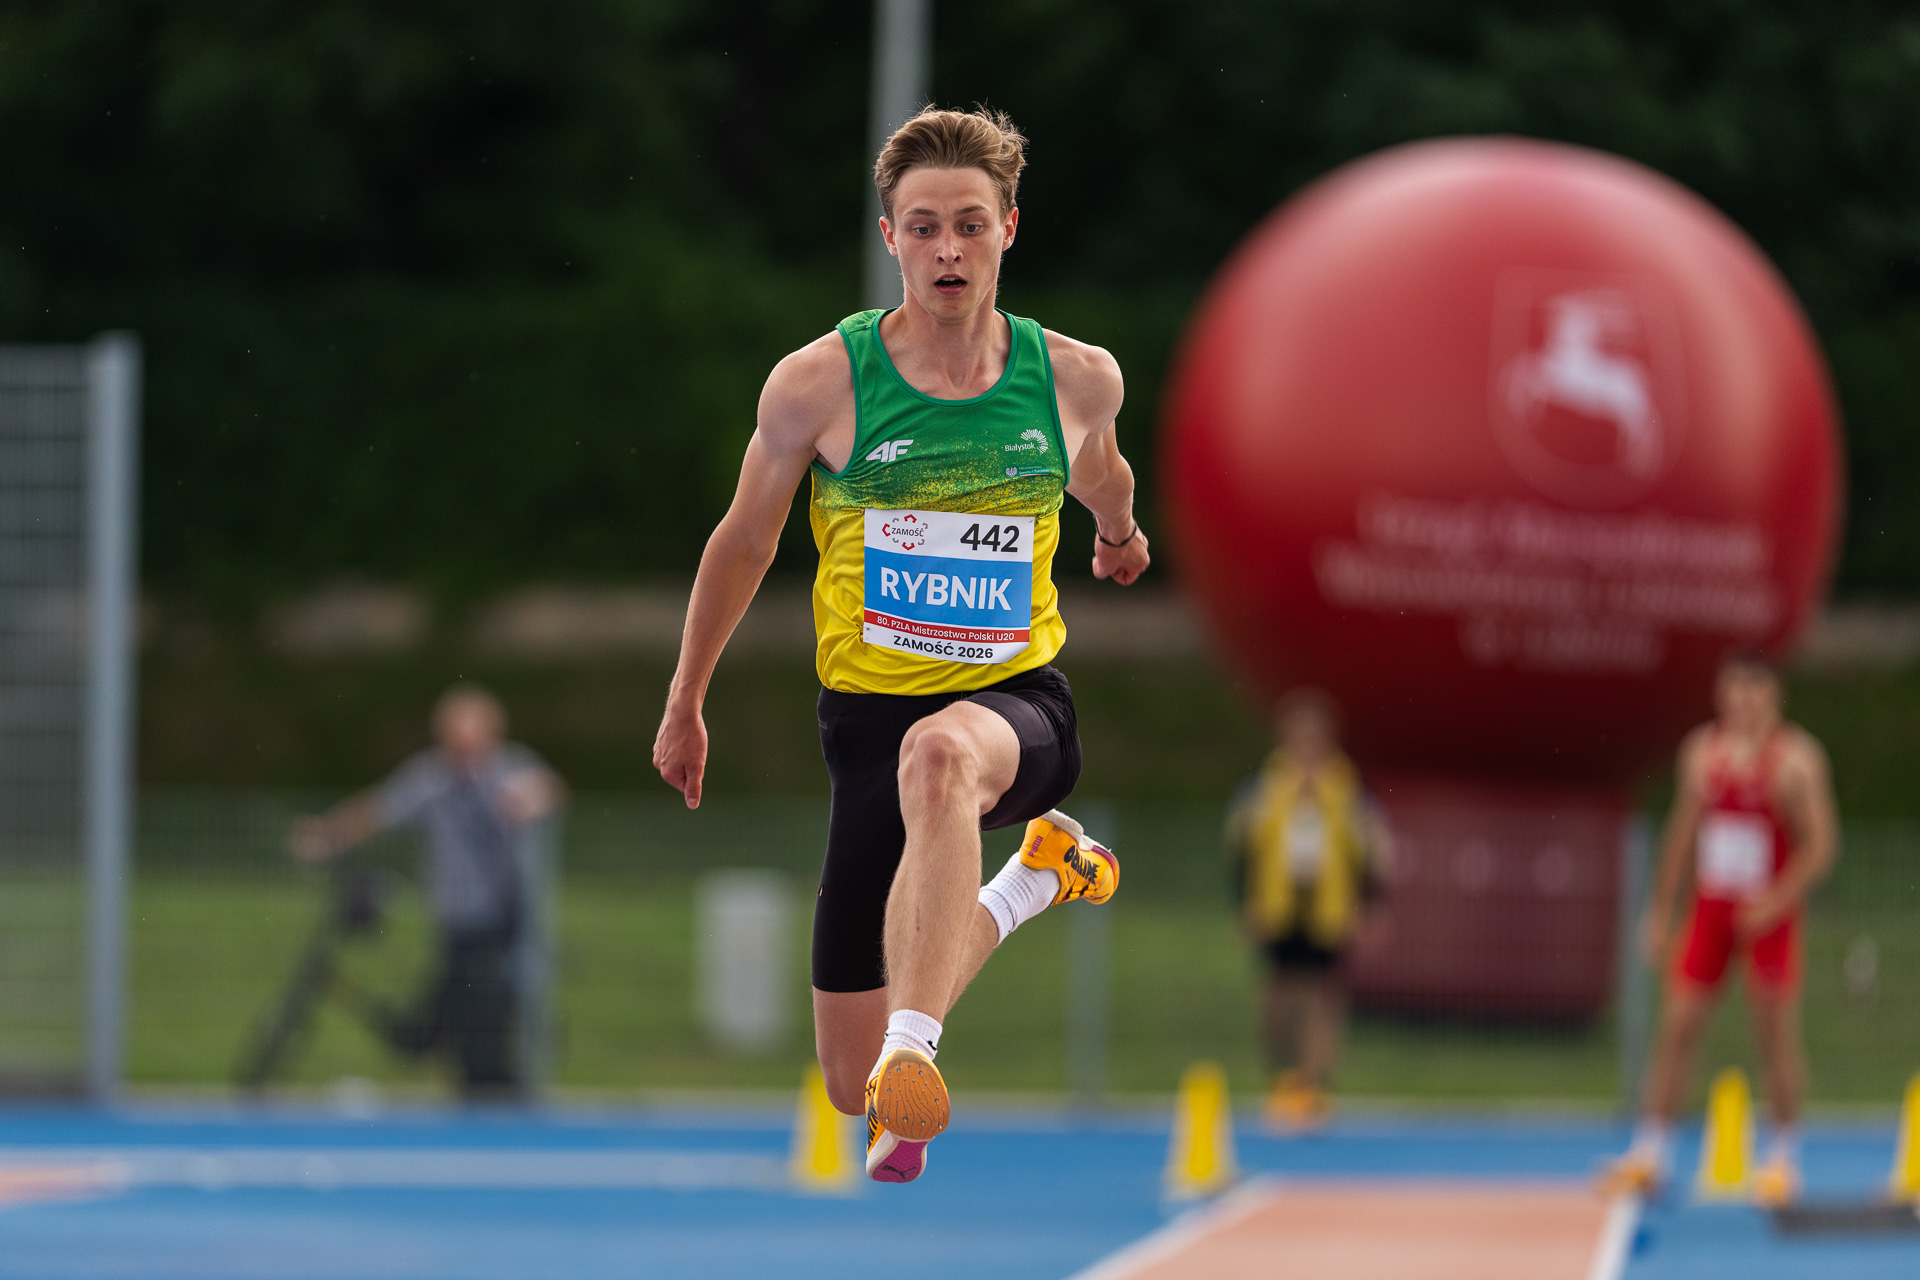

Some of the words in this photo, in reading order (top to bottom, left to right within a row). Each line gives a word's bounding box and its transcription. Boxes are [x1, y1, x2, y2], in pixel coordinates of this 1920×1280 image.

[891, 527, 924, 537] ZAMOŚĆ
[960, 523, 1020, 553] 442
[880, 566, 1012, 611] RYBNIK
[877, 615, 890, 627] 80.
[891, 619, 911, 632] PZLA
[912, 624, 966, 640] Mistrzostwa
[968, 632, 995, 641] Polski
[996, 632, 1015, 641] U20
[893, 635, 954, 655] ZAMOŚĆ
[957, 646, 994, 659] 2026
[1027, 835, 1044, 858] PUMA
